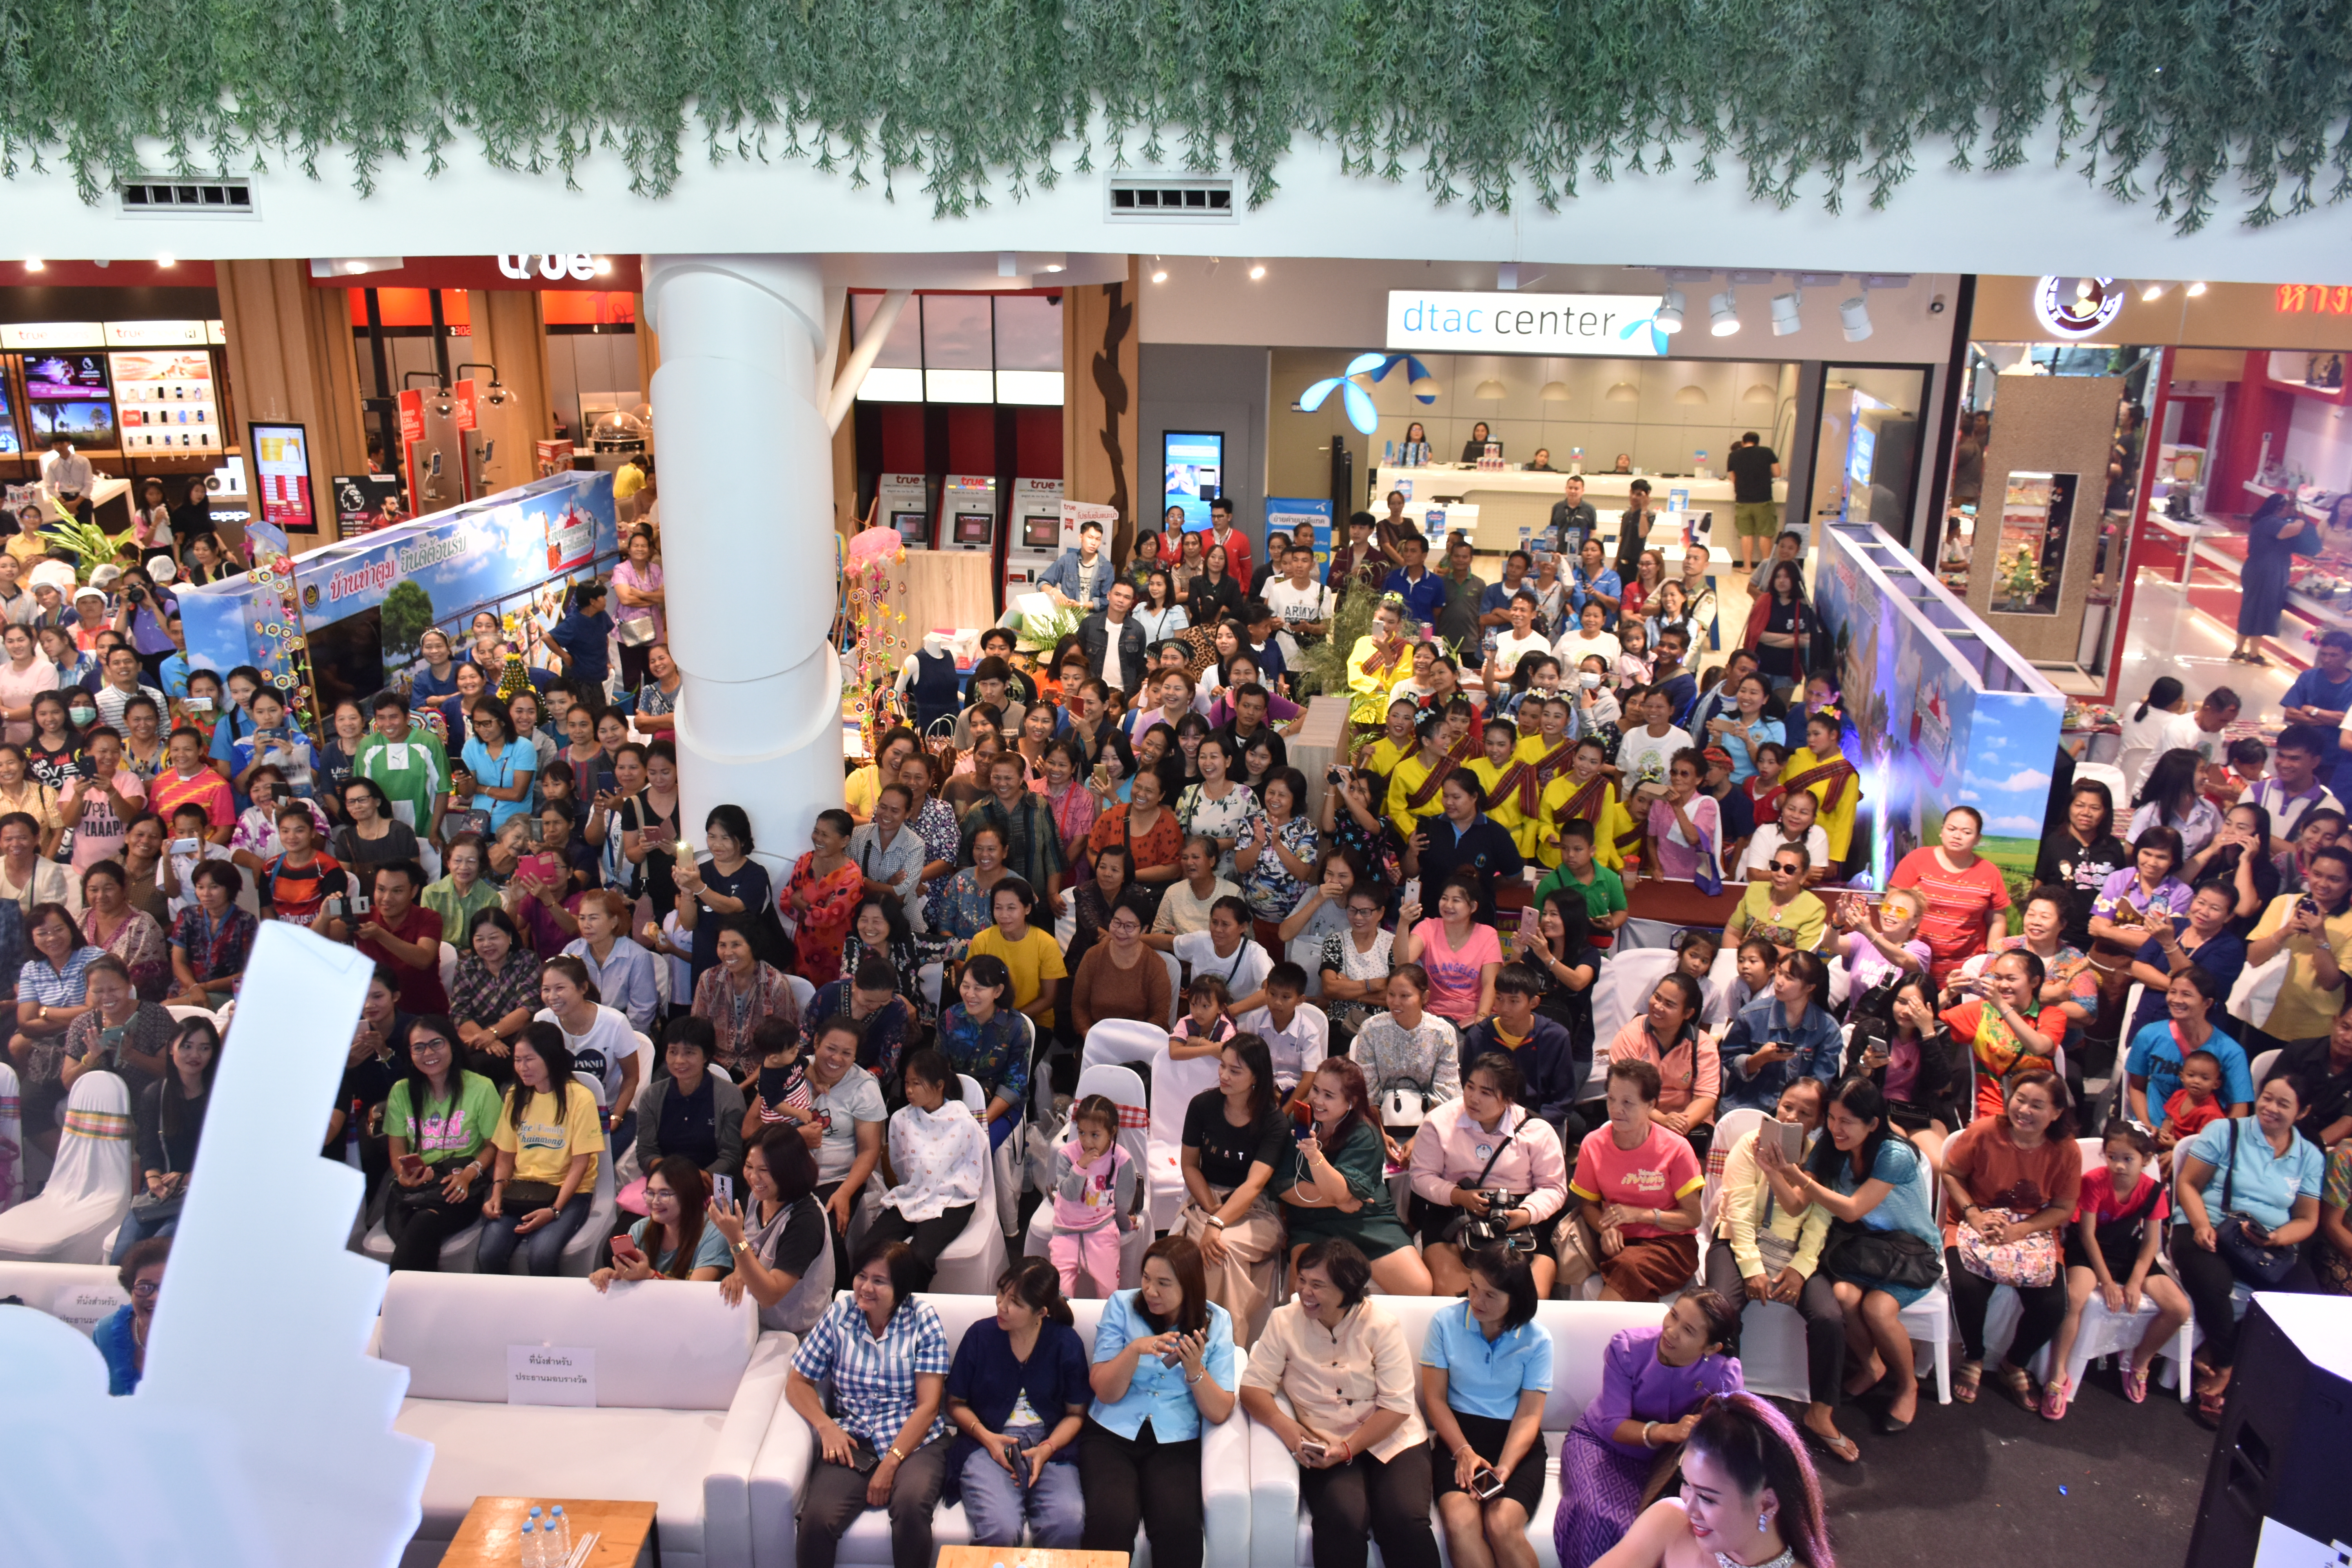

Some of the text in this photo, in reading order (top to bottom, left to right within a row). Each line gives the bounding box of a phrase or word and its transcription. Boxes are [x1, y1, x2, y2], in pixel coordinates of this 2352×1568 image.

[1404, 300, 1616, 336] dtac center
[19, 330, 49, 340] true
[116, 328, 145, 338] true
[896, 475, 920, 484] true
[961, 477, 985, 486] true
[1031, 480, 1055, 489] true
[330, 560, 395, 600] บ้านท่าตูม
[401, 532, 466, 573] ยินดีต้อนรับ
[1285, 606, 1315, 617] ARMY
[84, 821, 123, 837] ZAAAP!
[1441, 963, 1478, 980] ANGELES
[76, 1294, 118, 1306] ที่นั่งสำหรับ
[59, 1315, 99, 1324] ประธานม
[529, 1354, 572, 1366] ที่นั่งสำหรับ
[515, 1373, 588, 1384] ประธานมอบรางวัล
